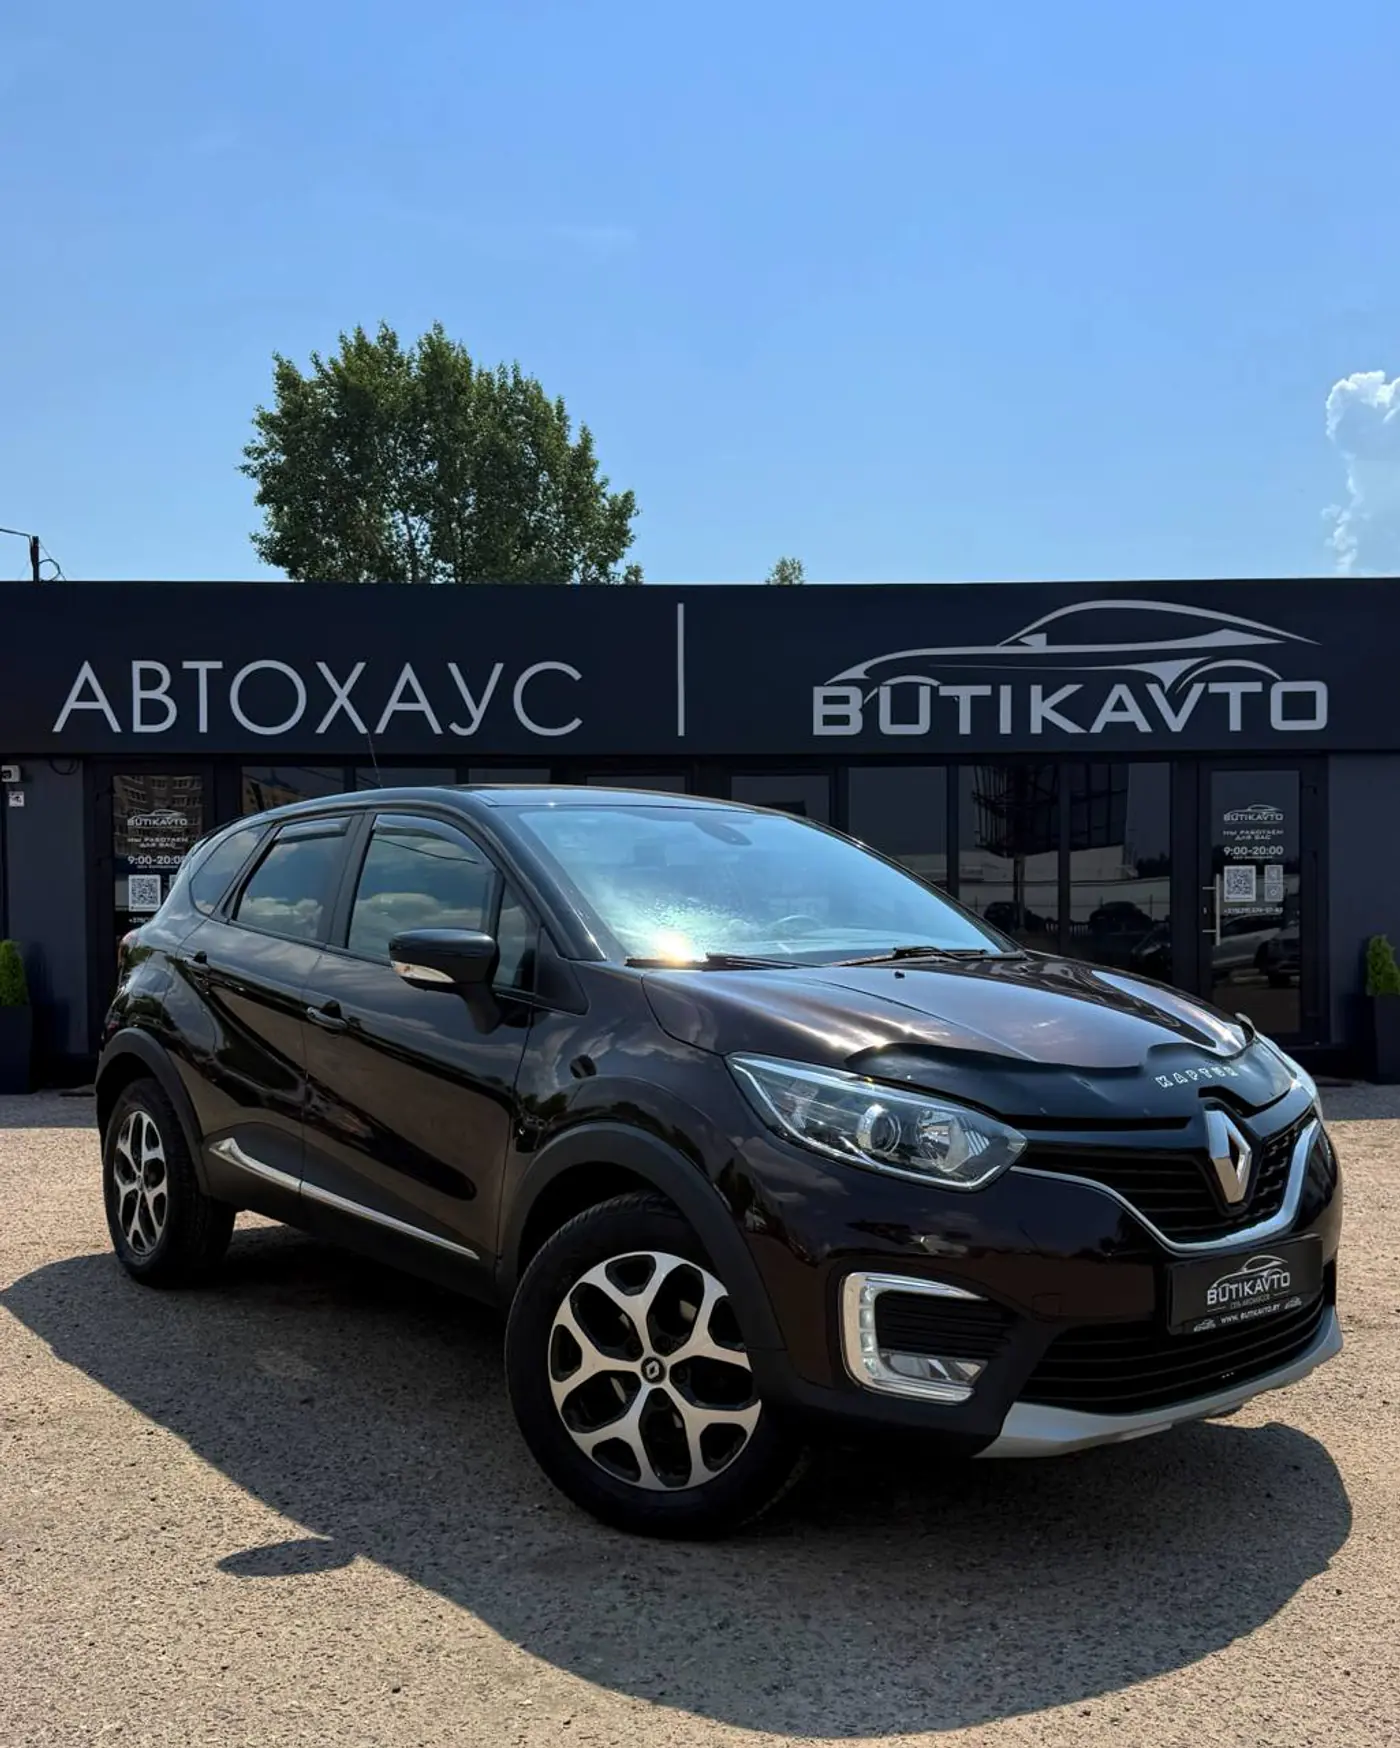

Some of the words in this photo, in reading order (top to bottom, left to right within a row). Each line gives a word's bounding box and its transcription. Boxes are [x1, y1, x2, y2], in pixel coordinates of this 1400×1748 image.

[53, 660, 583, 737] АВТОХАУС
[812, 681, 1328, 736] BUTIKAVTO
[127, 818, 188, 826] BUTIKAVTO
[1223, 813, 1284, 821] BUTIKAVTO
[1223, 846, 1284, 855] 9:00-20:00
[1207, 1272, 1291, 1305] BUTIKAVTO
